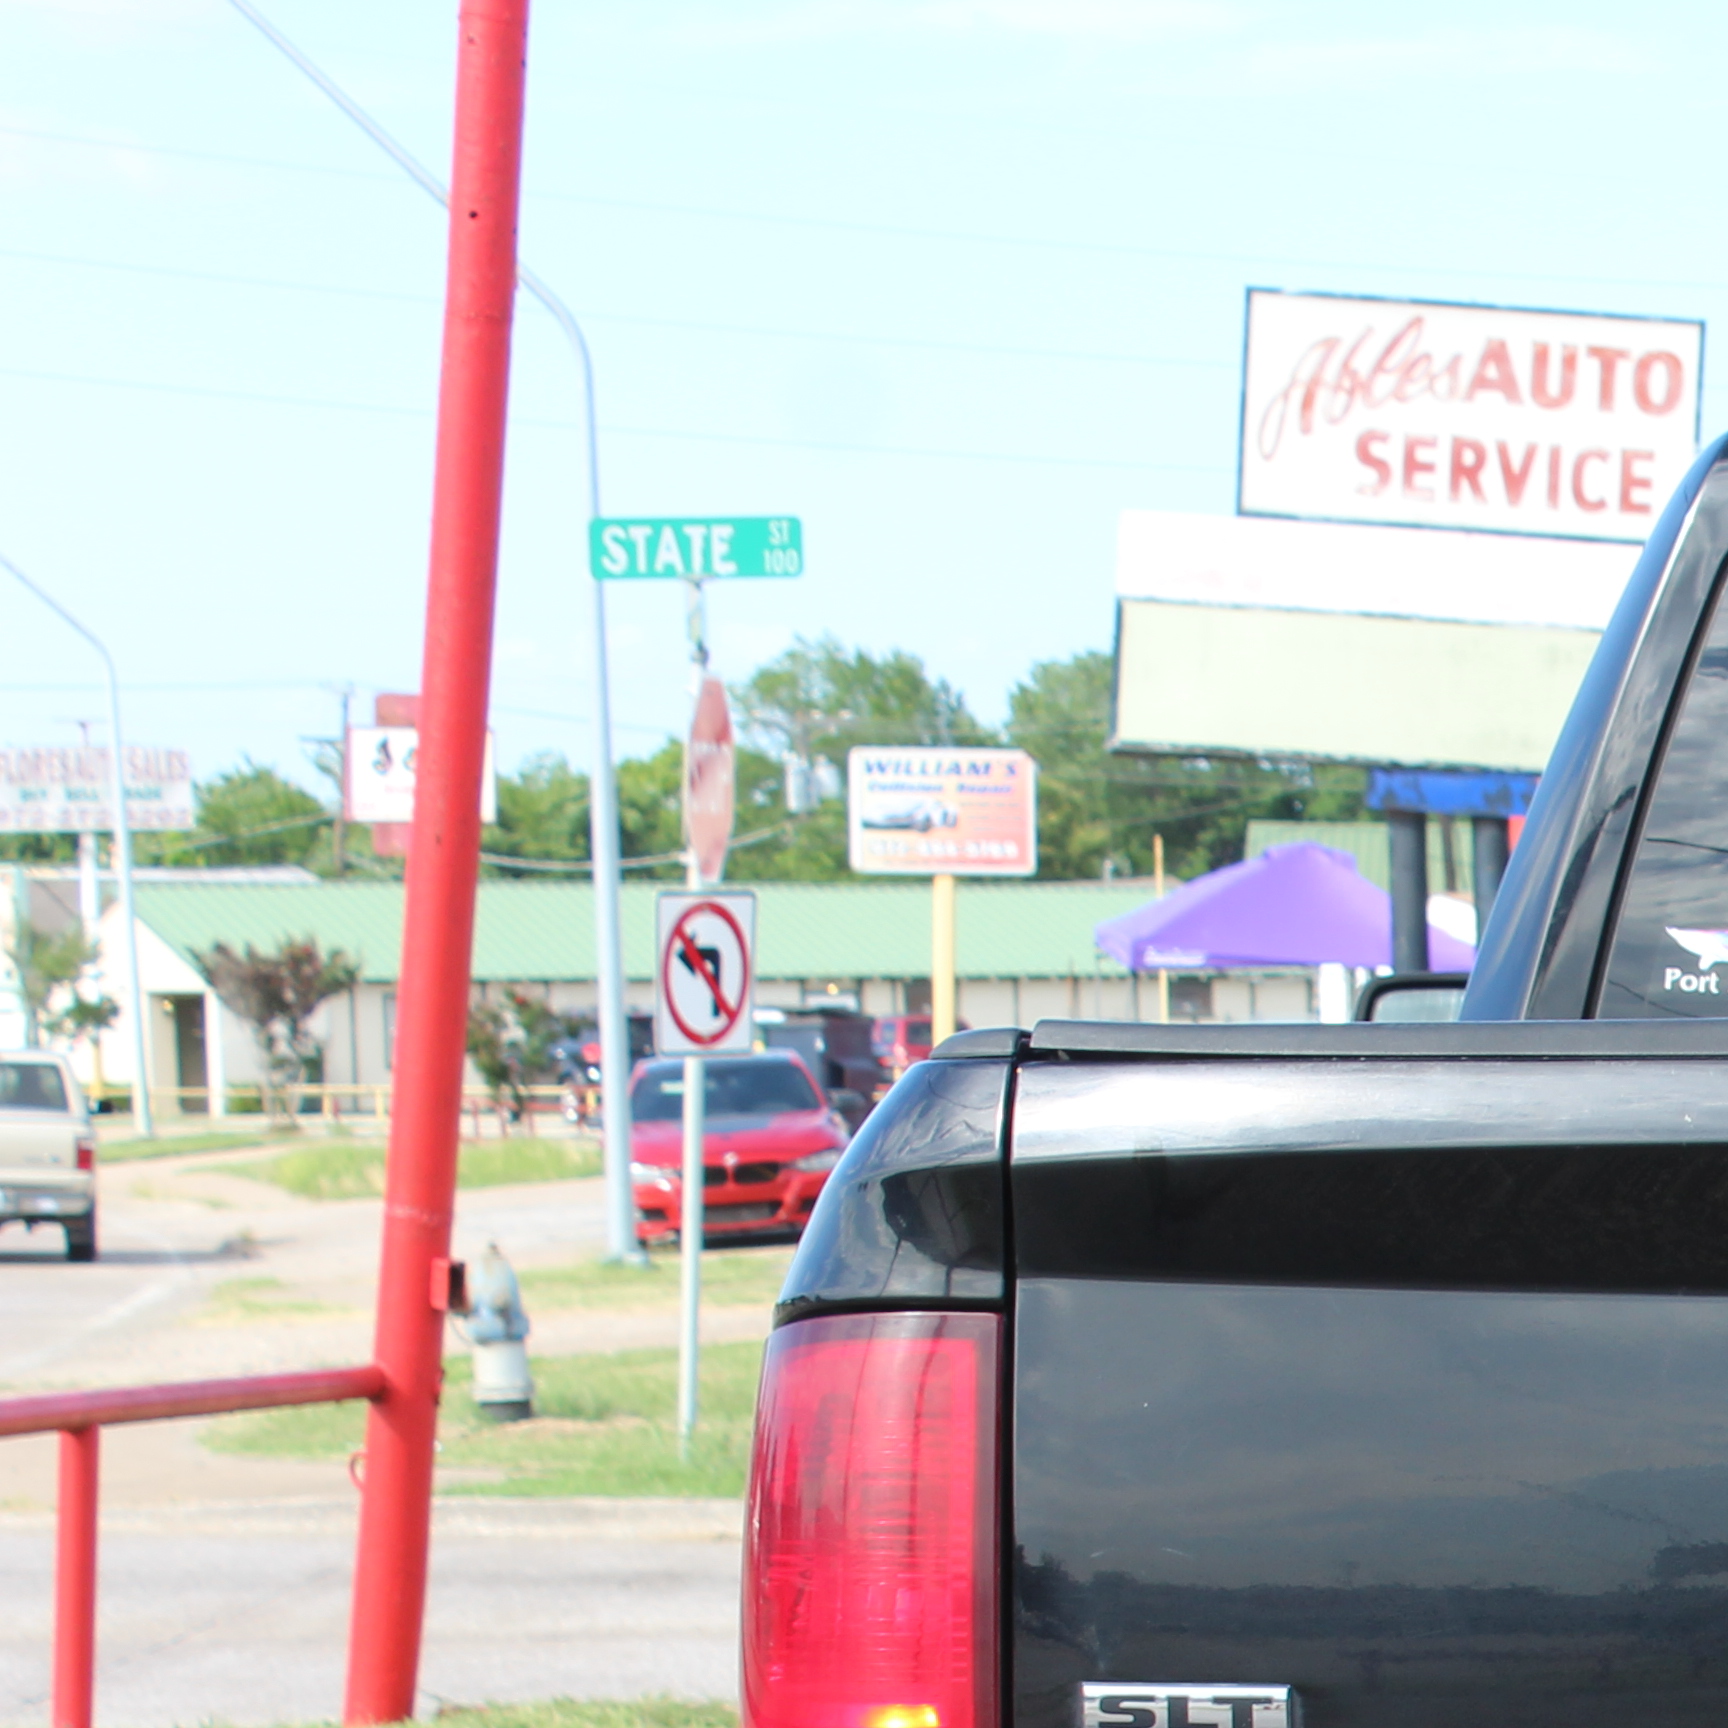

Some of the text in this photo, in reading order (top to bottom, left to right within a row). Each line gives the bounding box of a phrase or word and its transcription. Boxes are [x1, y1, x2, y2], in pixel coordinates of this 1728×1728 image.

[1464, 337, 1685, 416] AUTO
[1354, 428, 1657, 514] SERVICE
[601, 519, 790, 575] STATE ST
[763, 547, 799, 574] 100
[1663, 967, 1720, 994] Port
